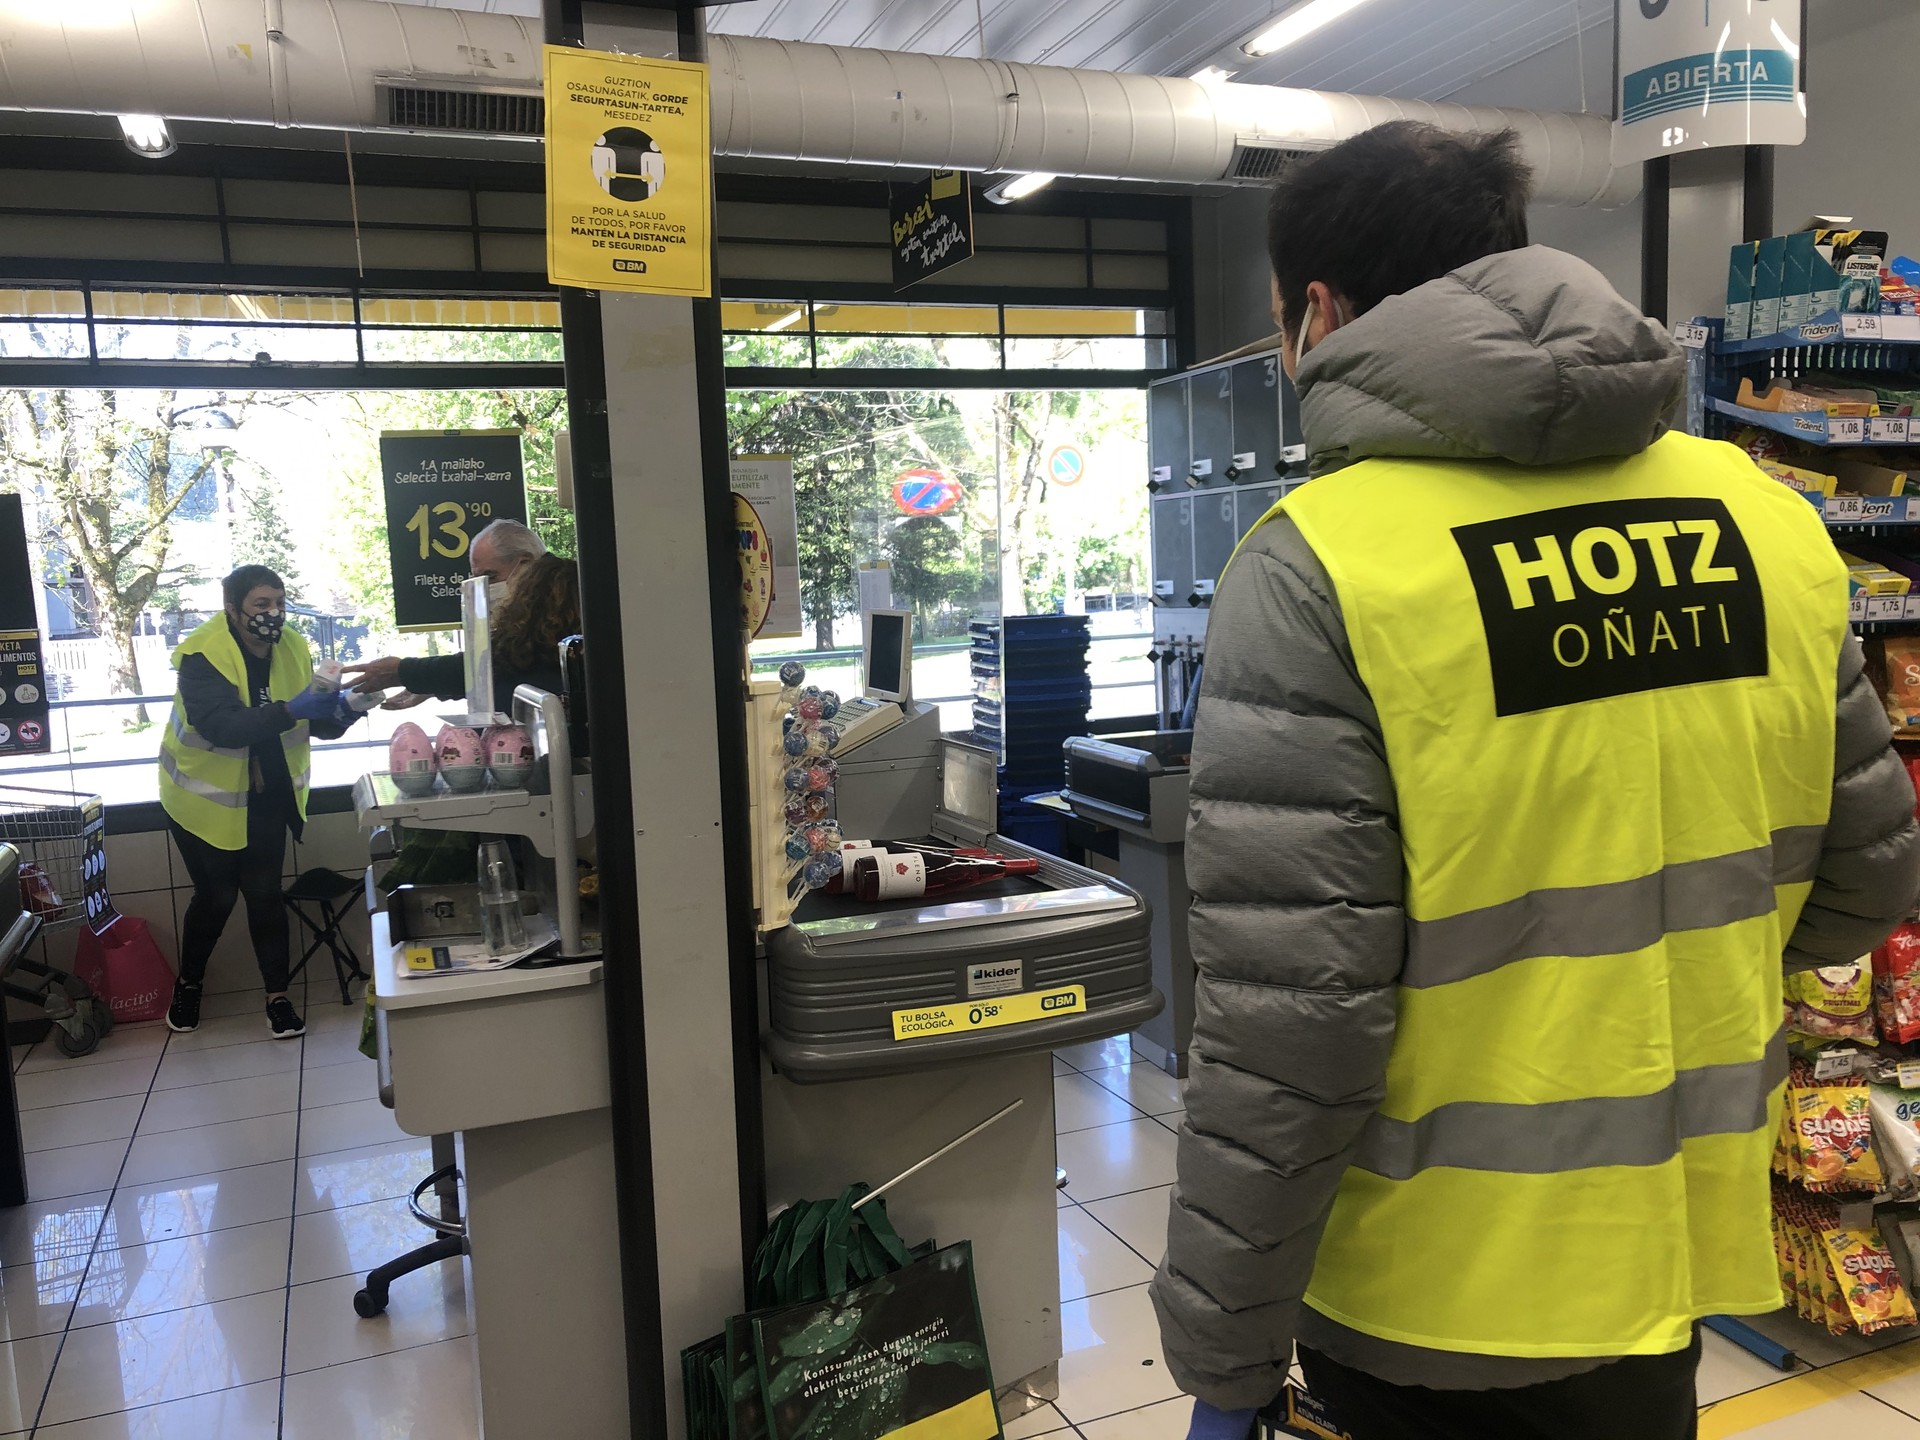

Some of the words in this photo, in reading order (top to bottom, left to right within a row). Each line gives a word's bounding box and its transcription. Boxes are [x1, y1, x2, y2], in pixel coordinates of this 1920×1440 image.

[604, 75, 651, 89] GUZTION
[1646, 61, 1769, 98] ABIERTA
[567, 82, 649, 101] OSASUNAGATIK,
[652, 93, 689, 105] GORDE
[570, 94, 685, 116] SEGURTASUN-TARTEA,
[604, 110, 652, 123] MESEDEZ
[592, 206, 614, 217] POR
[617, 209, 630, 218] LA
[633, 210, 666, 221] SALUD
[571, 215, 586, 225] DE
[588, 217, 626, 229] TODOS,
[629, 219, 651, 231] POR
[653, 222, 686, 234] FAVOR
[571, 226, 614, 238] MANTÉN
[617, 230, 631, 240] LA
[633, 231, 687, 244] DISTANCIA
[592, 239, 606, 248] DE
[608, 240, 666, 253] SEGURIDAD
[626, 261, 645, 272] BM
[1847, 262, 1880, 270] LISTERINE
[1799, 323, 1841, 338] Trident
[1263, 358, 1277, 388] 3
[1218, 370, 1230, 398] 2
[1793, 417, 1825, 433] Trident
[441, 457, 485, 470] mailako
[395, 472, 437, 484] Selecta
[441, 470, 512, 483] txahal-xerra
[1179, 500, 1191, 525] 5
[1220, 494, 1233, 522] 6
[1861, 501, 1893, 515] dent
[1492, 519, 1739, 610] HOTZ
[414, 573, 446, 586] Filete
[450, 572, 464, 584] de
[431, 586, 463, 598] Selec
[1553, 603, 1730, 667] OÑATI
[0, 641, 21, 651] KETA
[0, 652, 37, 663] LIMENTOS
[912, 855, 922, 883] PLENO
[984, 967, 1021, 978] kider
[1055, 995, 1073, 1007] BM
[900, 1013, 913, 1023] TU
[915, 1011, 946, 1022] BOLSA
[901, 1019, 954, 1033] ECOLÓGICA
[1801, 1116, 1872, 1138] sugus
[1844, 1253, 1897, 1275] sugus
[803, 1349, 880, 1382] Kontsumitzen
[882, 1334, 912, 1352] dugun
[914, 1317, 944, 1337] energia
[804, 1364, 876, 1398] elektrikoaren
[920, 1326, 950, 1351] jatorri
[837, 1364, 909, 1399] berriztagarria
